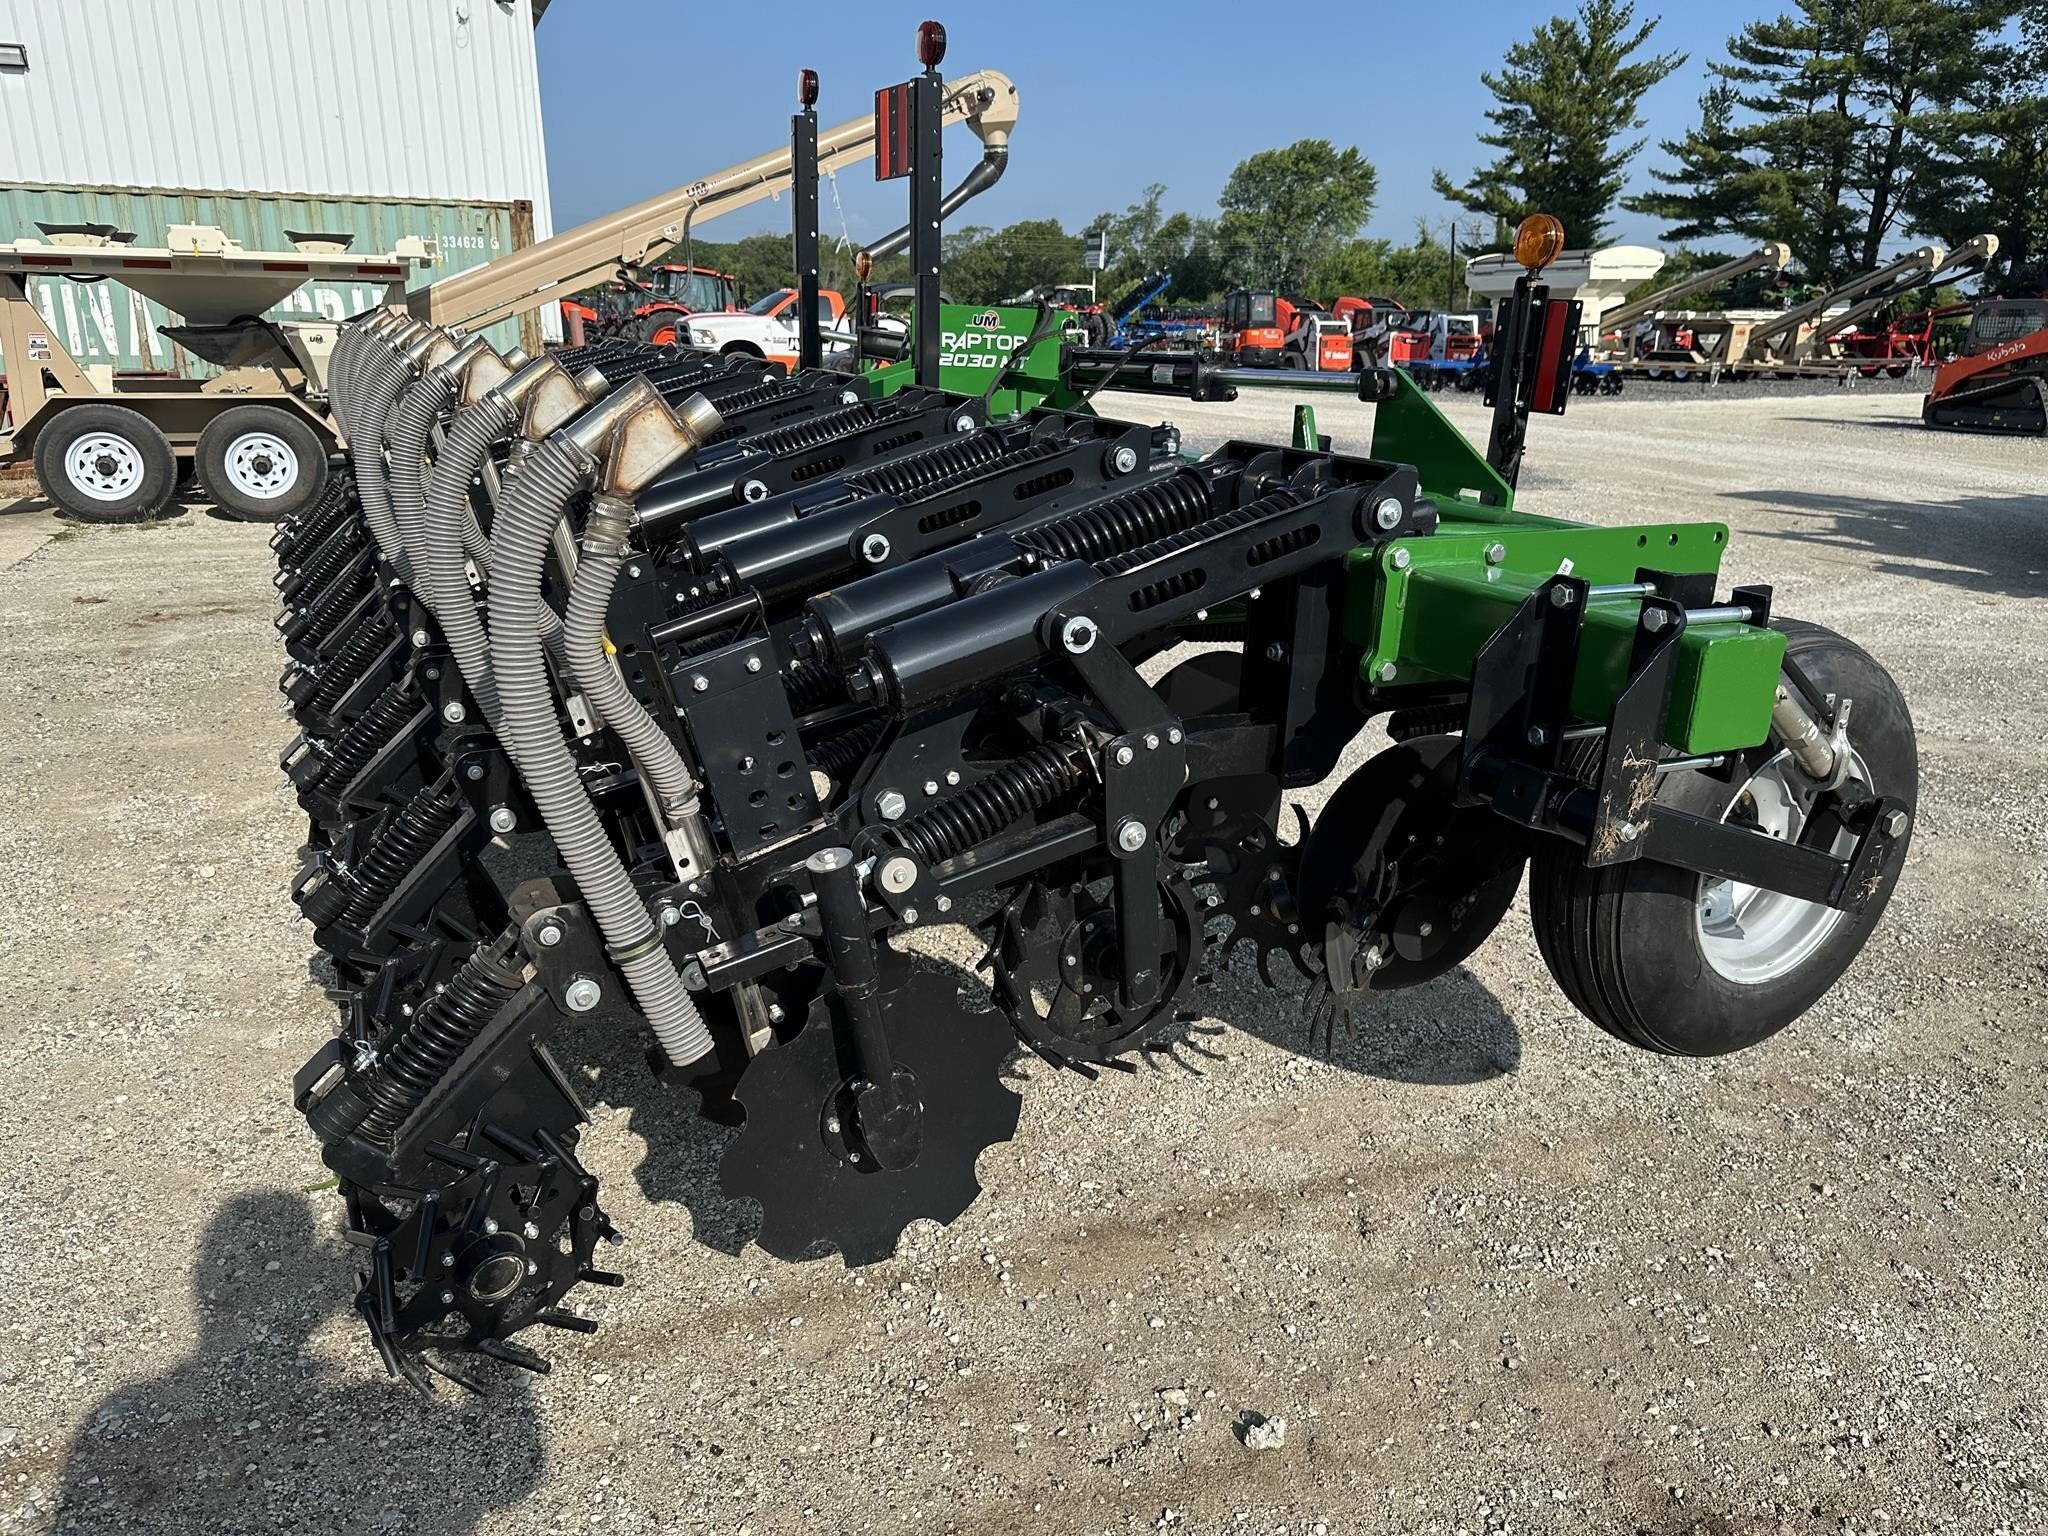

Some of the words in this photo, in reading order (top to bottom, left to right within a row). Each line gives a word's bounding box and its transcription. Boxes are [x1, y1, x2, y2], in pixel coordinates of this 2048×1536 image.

[686, 181, 709, 197] UM
[442, 236, 484, 249] 334628
[972, 313, 997, 327] UM
[309, 335, 323, 343] UM
[1987, 342, 2026, 361] Kubota
[939, 353, 997, 369] 2030
